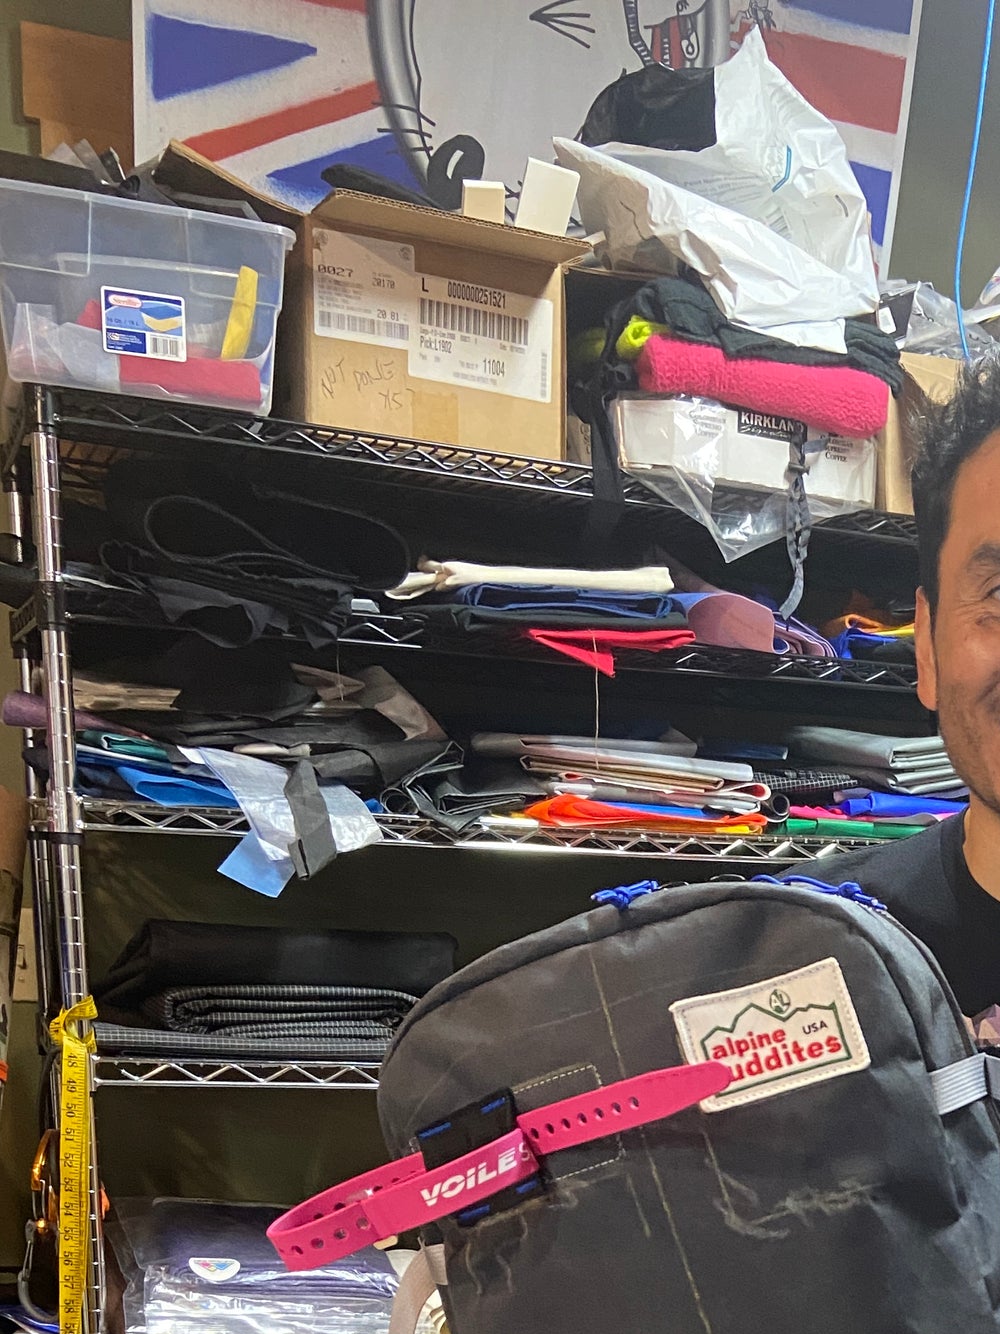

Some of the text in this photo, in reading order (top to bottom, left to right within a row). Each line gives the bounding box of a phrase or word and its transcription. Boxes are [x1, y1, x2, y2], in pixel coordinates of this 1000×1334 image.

[803, 1020, 828, 1035] USA
[711, 1028, 787, 1060] alpine
[66, 1053, 78, 1068] 48
[728, 1035, 843, 1083] uddites
[66, 1077, 77, 1093] 49
[65, 1102, 76, 1118] 50
[65, 1127, 75, 1141] 51
[63, 1152, 74, 1168] 52
[64, 1177, 73, 1192] 53
[420, 1147, 518, 1207] VOILE
[63, 1201, 74, 1216] 54
[63, 1226, 73, 1241] 55
[63, 1275, 74, 1290] 57
[64, 1298, 74, 1314] 58
